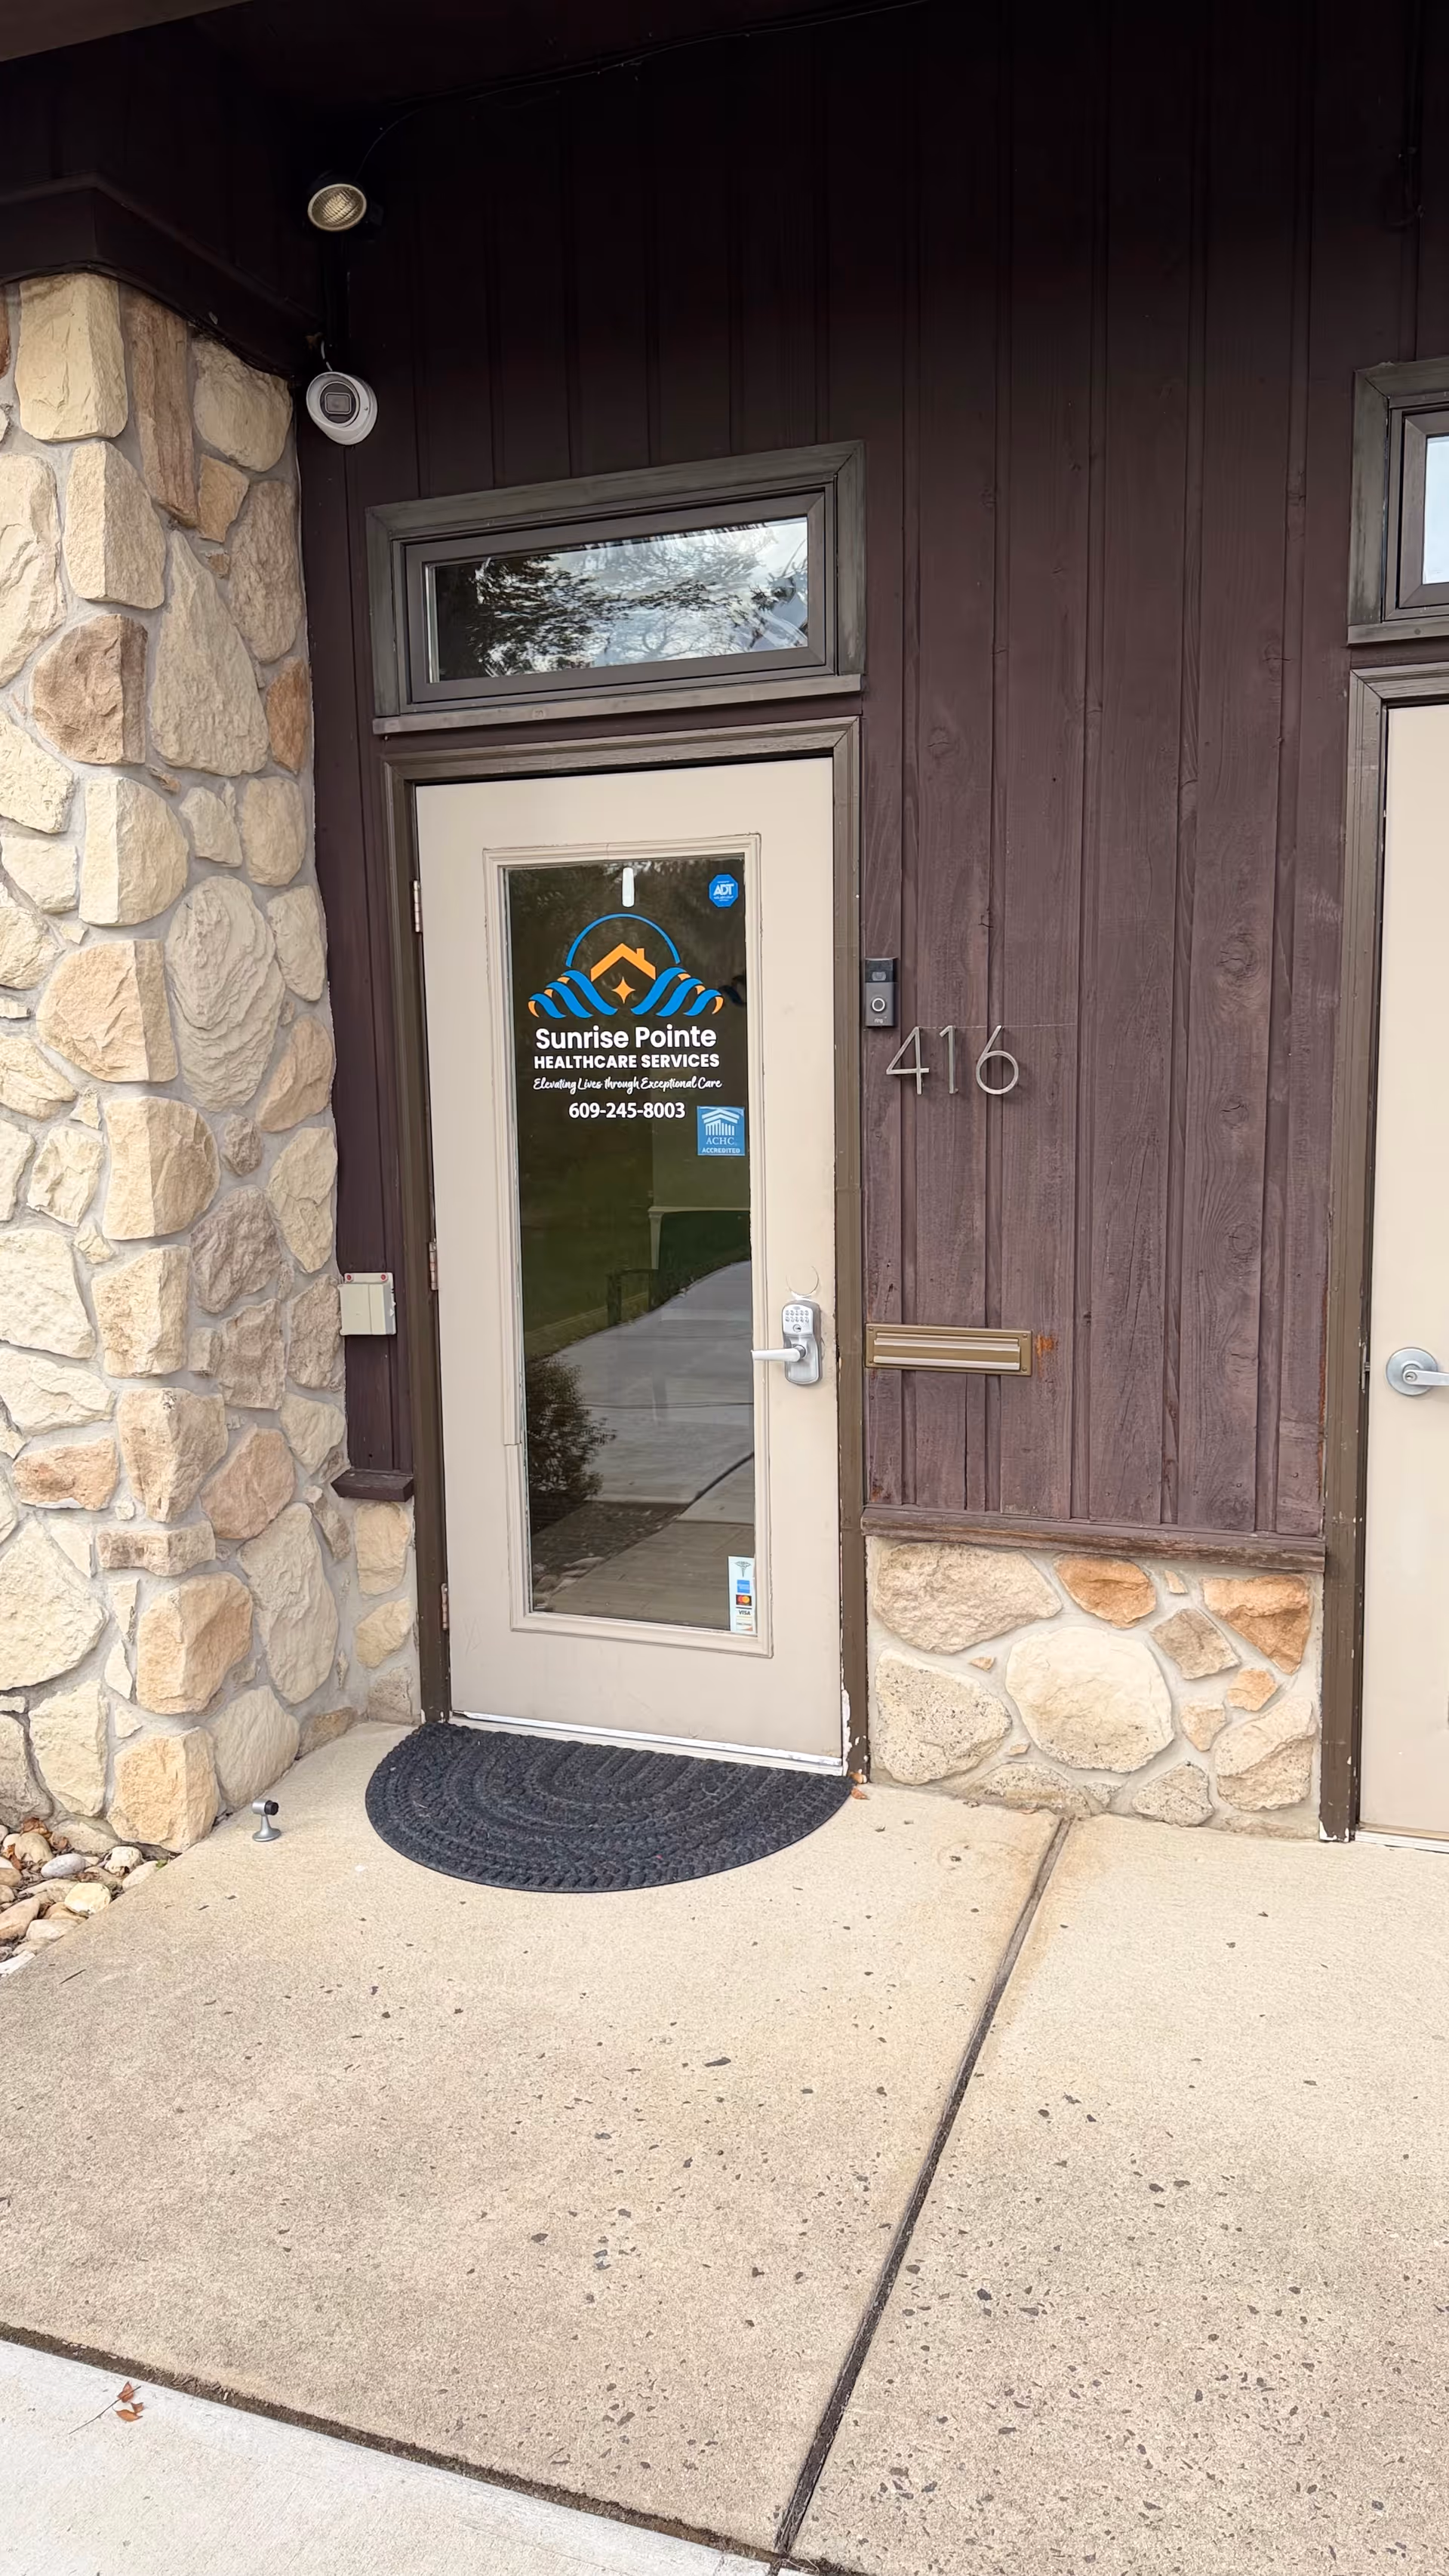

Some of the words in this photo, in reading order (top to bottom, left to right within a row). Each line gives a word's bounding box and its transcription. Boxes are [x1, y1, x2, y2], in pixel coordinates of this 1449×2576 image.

[713, 883, 734, 895] ADT
[535, 1025, 629, 1049] Sunrise
[635, 1024, 717, 1048] Pointe
[534, 1055, 637, 1069] HEALTHCARE
[641, 1054, 719, 1068] SERVICES
[886, 1025, 1019, 1094] 416
[533, 1077, 577, 1094] Elevating
[577, 1077, 602, 1090] Lives
[605, 1078, 639, 1094] through
[641, 1076, 697, 1093] Exceptional
[697, 1076, 722, 1089] Care
[568, 1102, 685, 1119] 609-245-8003
[706, 1137, 734, 1146] ACHC
